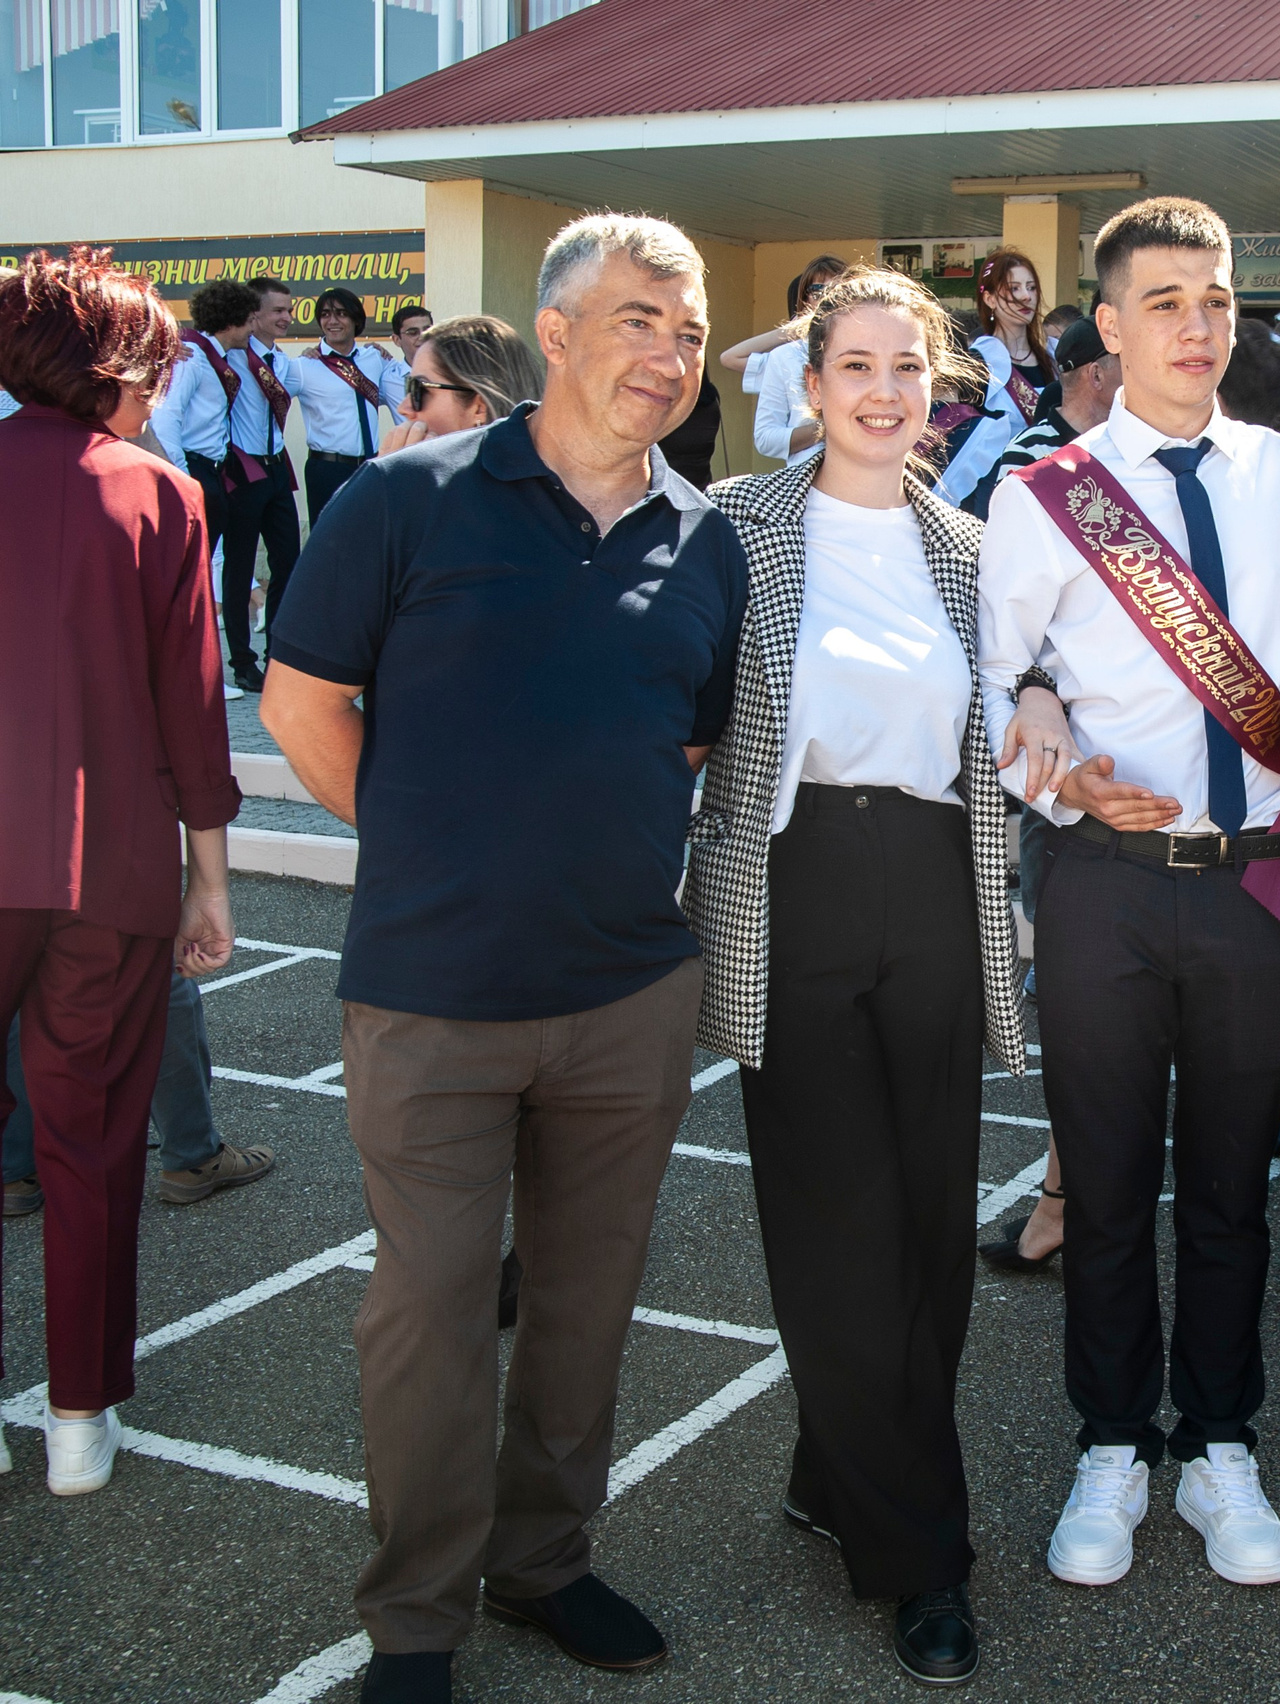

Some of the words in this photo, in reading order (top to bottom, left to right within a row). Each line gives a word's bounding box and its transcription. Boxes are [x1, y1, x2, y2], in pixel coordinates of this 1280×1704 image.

[111, 258, 209, 287] изни
[216, 252, 410, 286] мечтали,
[1099, 526, 1257, 705] Выпускник
